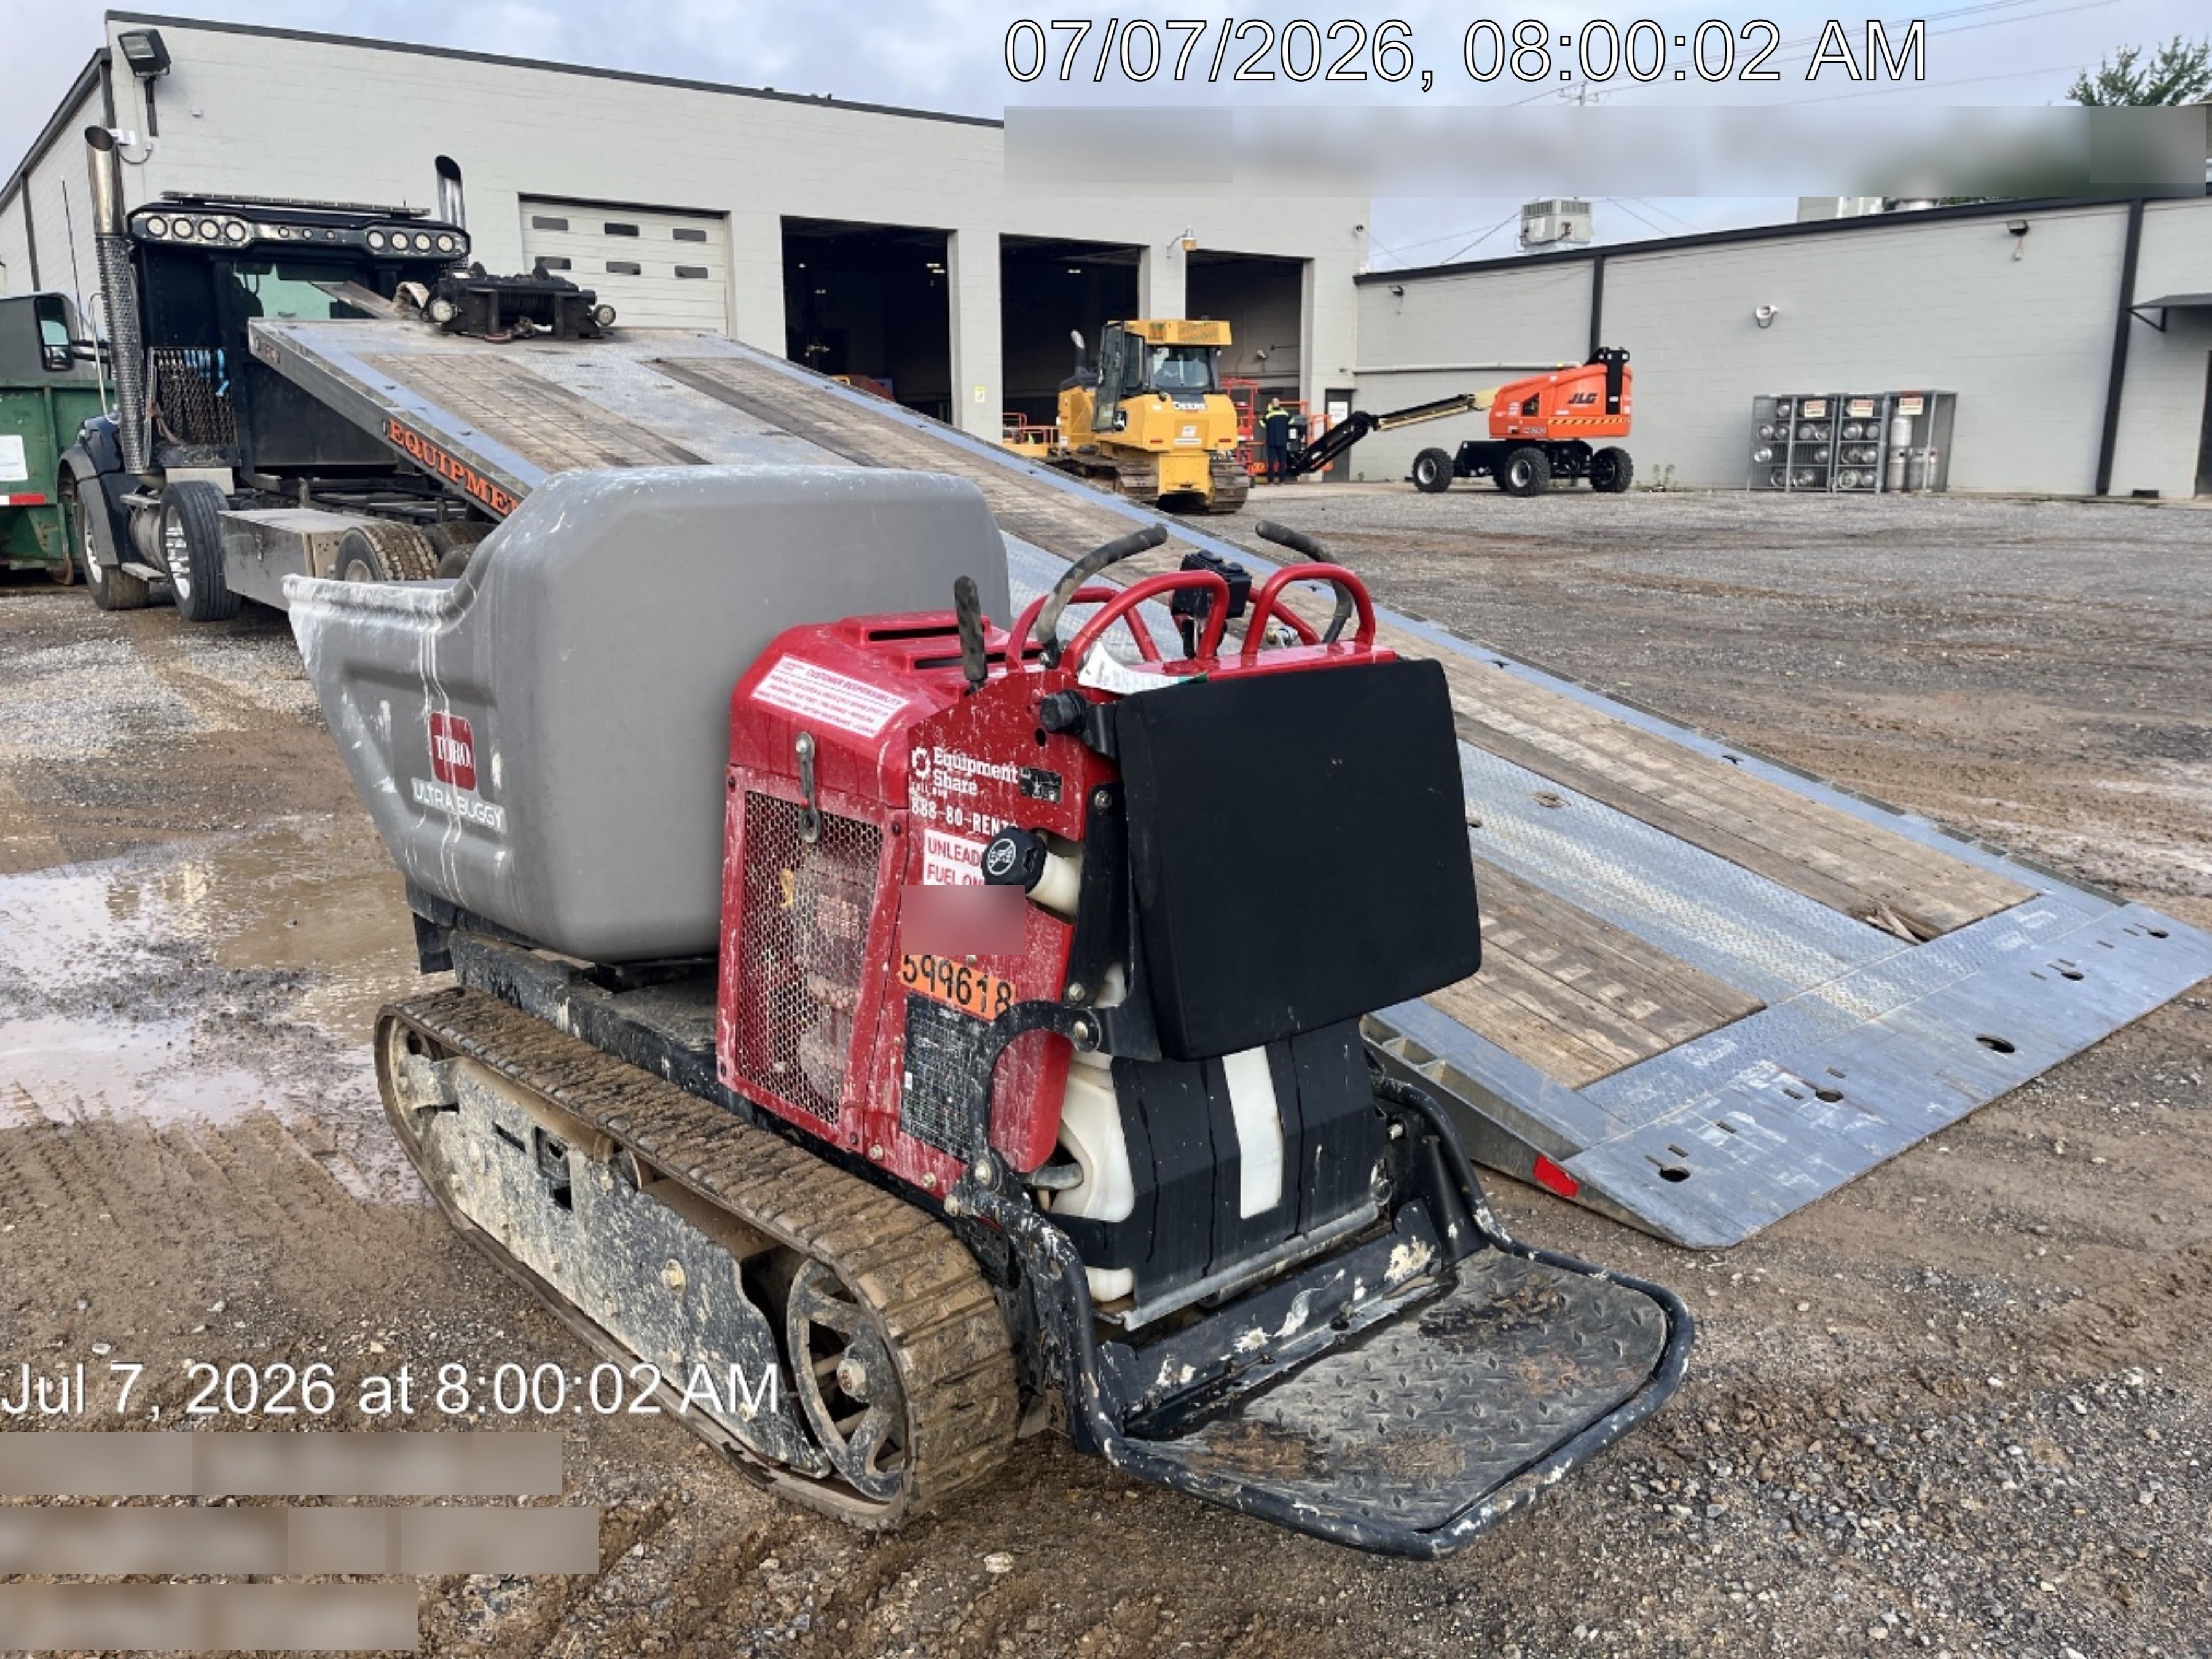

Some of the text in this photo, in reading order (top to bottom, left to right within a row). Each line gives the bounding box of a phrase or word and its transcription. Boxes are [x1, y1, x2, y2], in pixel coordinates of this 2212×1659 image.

[1567, 393, 1598, 404] JLG
[932, 746, 1019, 785] Equipment
[932, 768, 978, 796] Share
[412, 780, 503, 828] ULTRA BUGGY
[928, 836, 983, 868] UNLEAD
[903, 955, 1012, 1014] 599618
